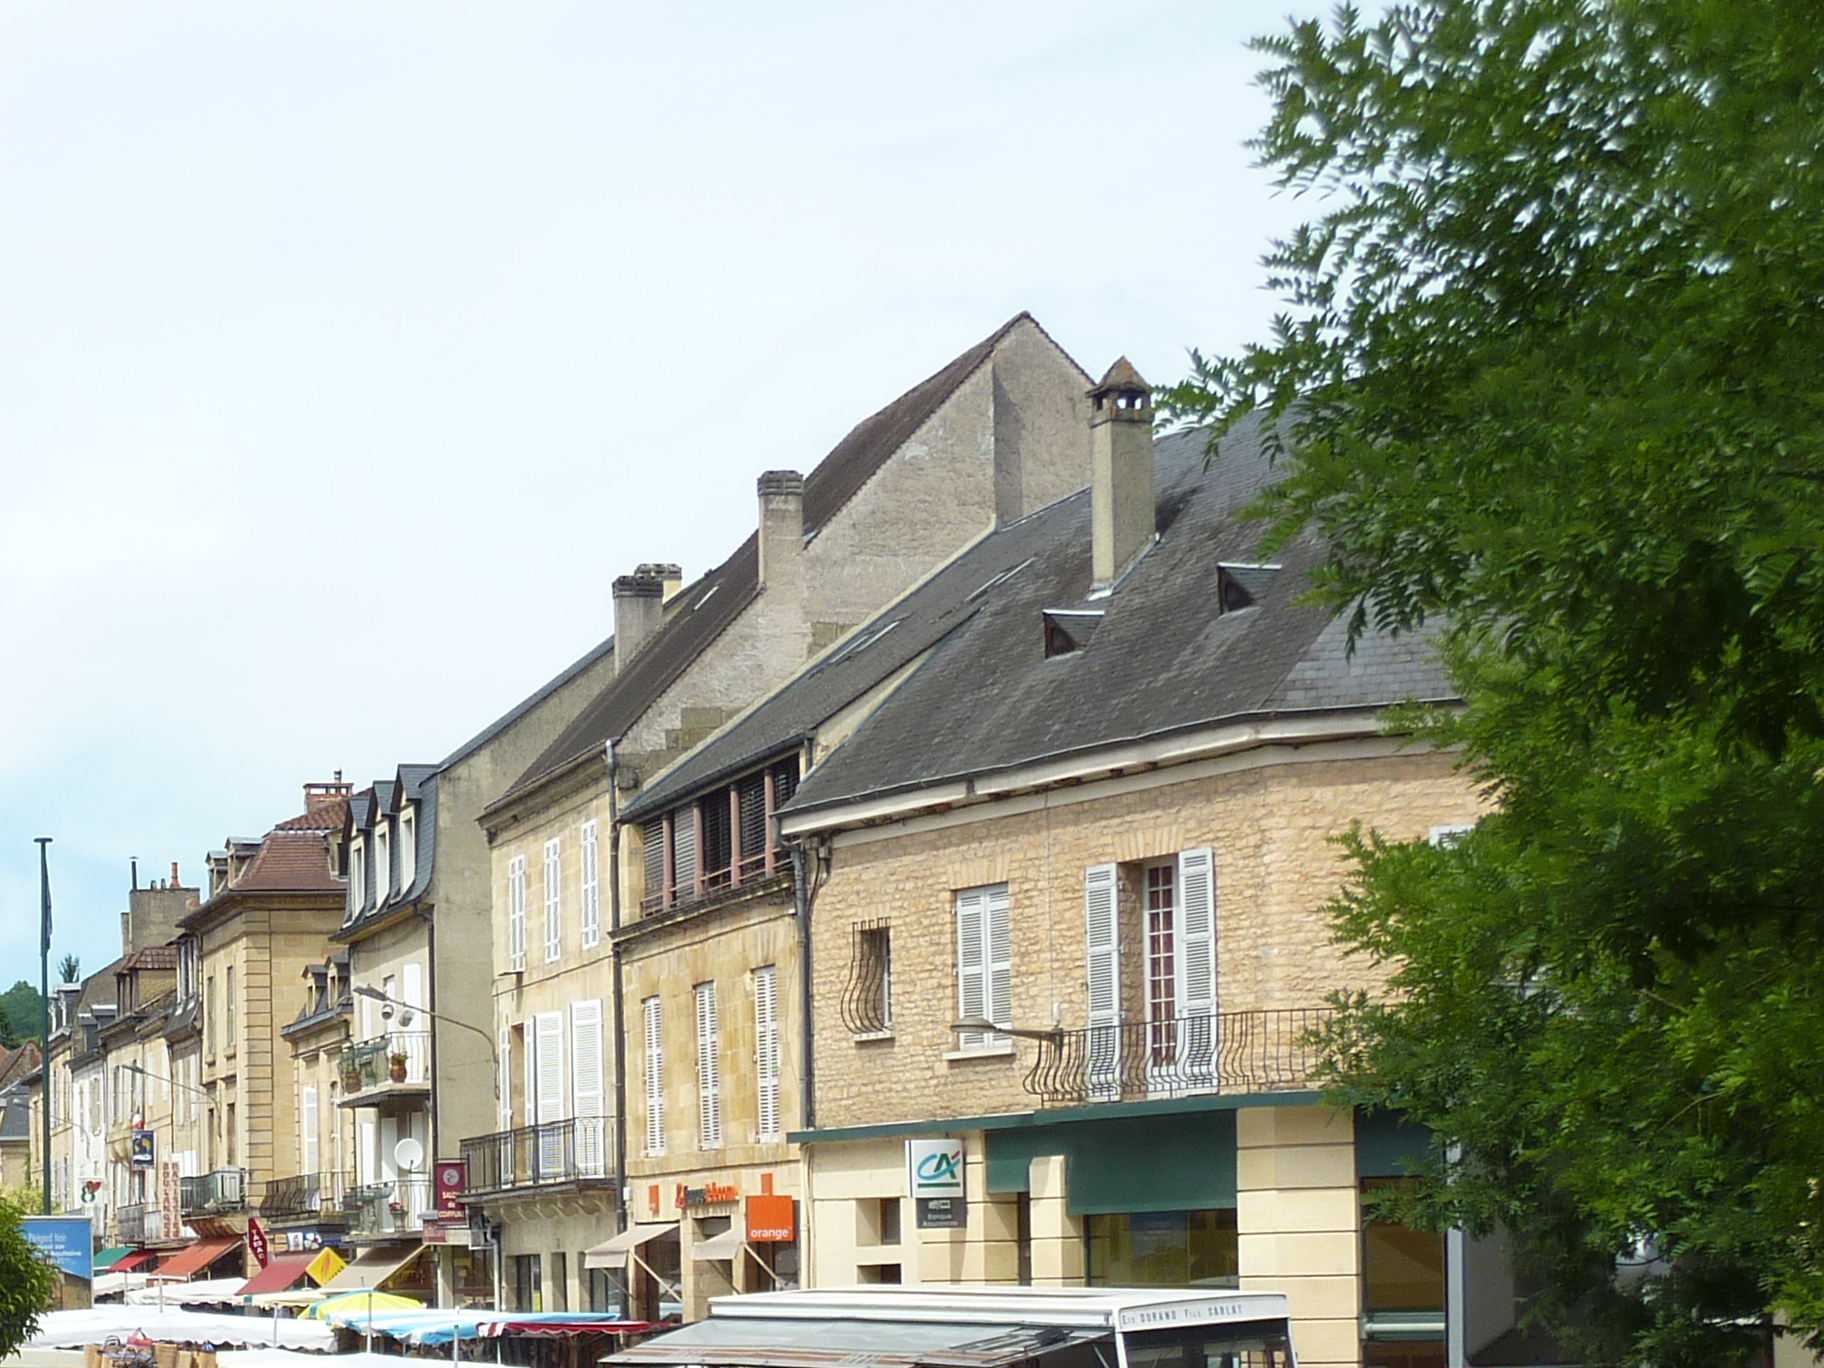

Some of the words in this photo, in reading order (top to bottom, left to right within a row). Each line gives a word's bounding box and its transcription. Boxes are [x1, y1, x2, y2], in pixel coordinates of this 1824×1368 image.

[251, 1229, 265, 1259] TABAC
[750, 1229, 789, 1240] orange
[1140, 1310, 1177, 1323] DURAND
[1208, 1304, 1242, 1317] SARLAT
